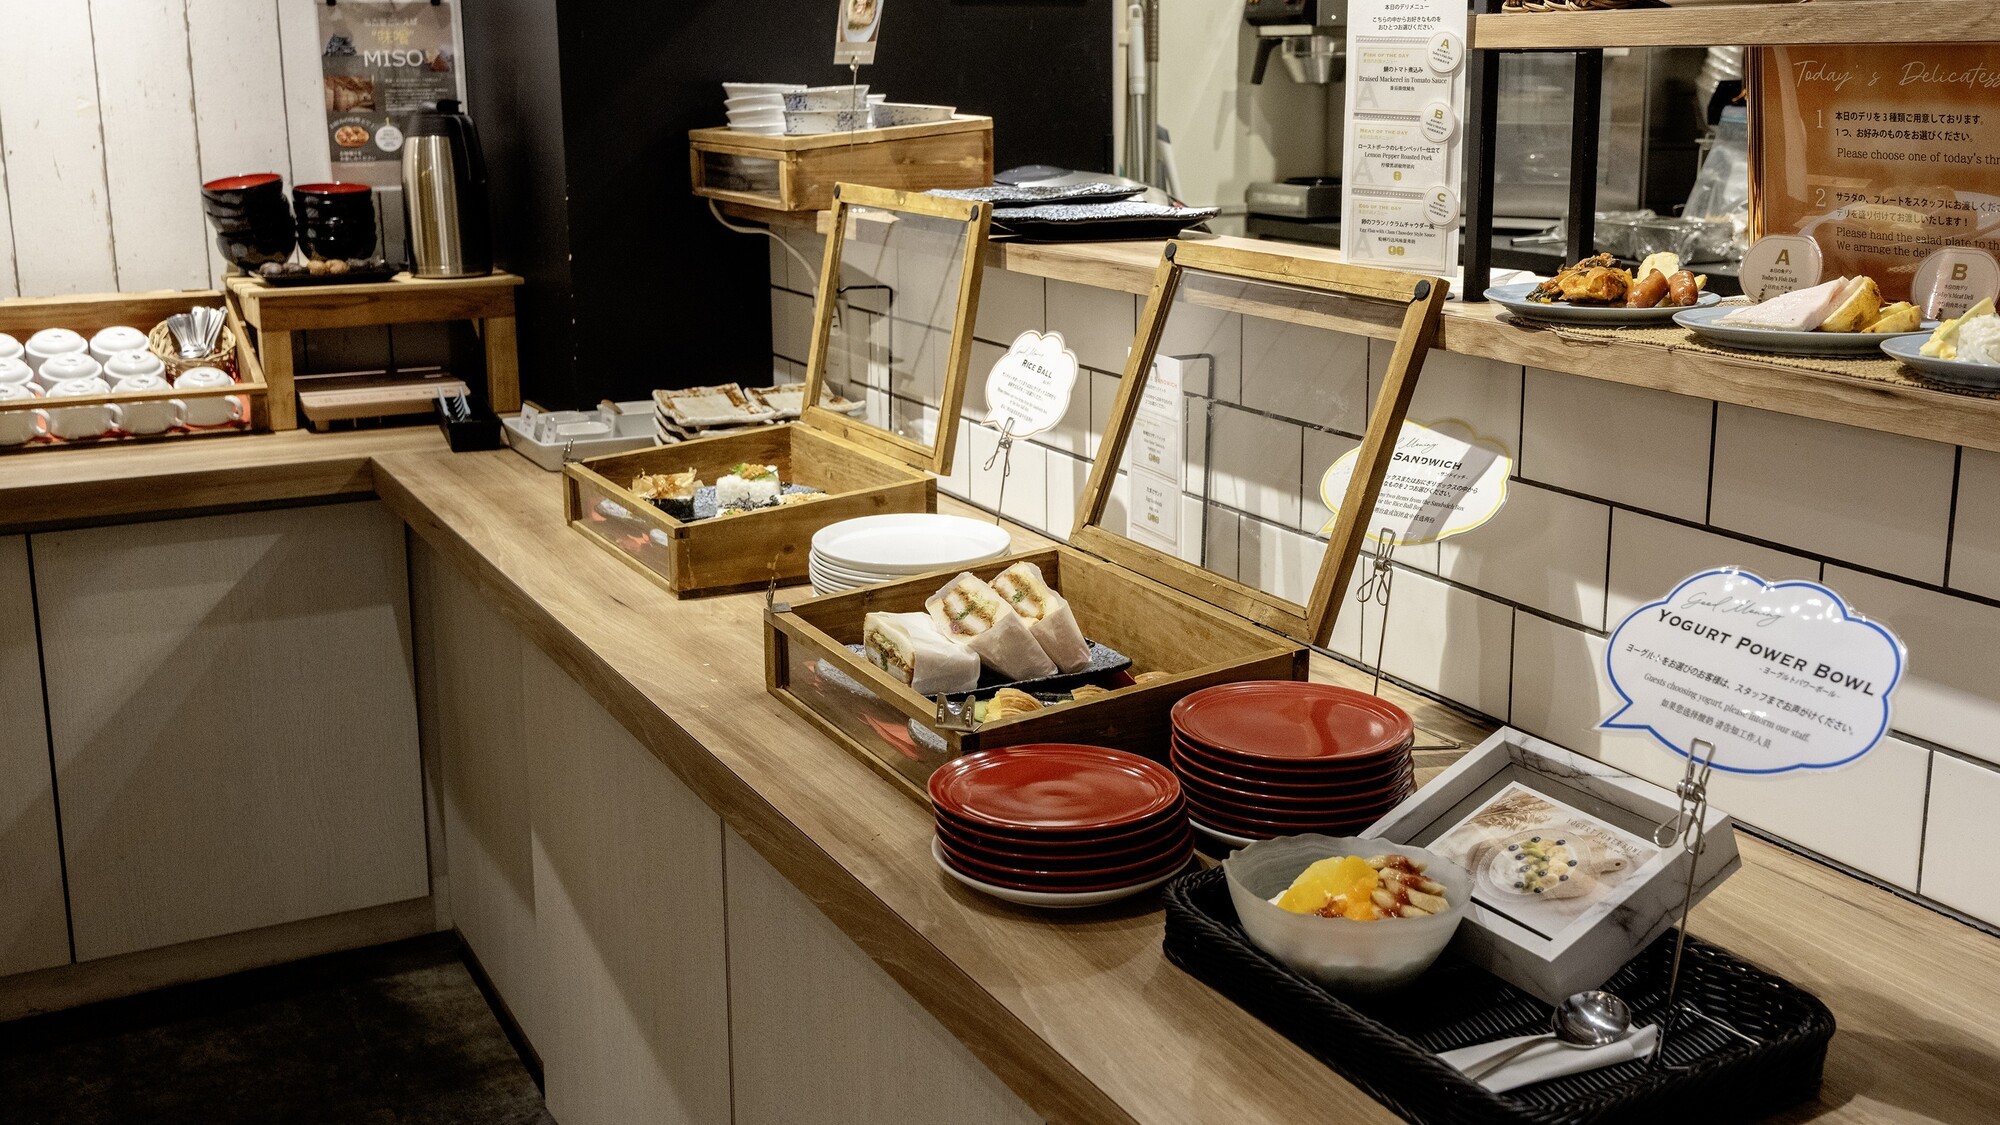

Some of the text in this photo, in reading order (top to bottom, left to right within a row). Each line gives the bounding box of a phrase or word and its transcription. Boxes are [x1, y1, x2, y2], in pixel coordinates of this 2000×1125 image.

[1441, 38, 1449, 49] A
[363, 50, 423, 67] MISO
[1359, 75, 1378, 83] Braised
[1435, 109, 1443, 120] B
[1816, 109, 1823, 129] 1
[1837, 147, 1868, 160] Please
[1870, 148, 1905, 161] choose
[1908, 152, 1926, 163] one
[1929, 151, 1942, 163] of
[1944, 152, 1982, 166] today's
[1437, 193, 1446, 202] C
[1815, 188, 1826, 207] 2
[1836, 227, 1868, 240] Please
[1870, 229, 1894, 242] hand
[1896, 231, 1913, 243] the
[1915, 233, 1942, 246] salad
[1945, 236, 1972, 248] plate
[1973, 239, 1986, 249] to
[1836, 240, 1851, 251] We
[1853, 243, 1891, 256] arrange
[1894, 244, 1910, 256] the
[1775, 249, 1790, 265] A
[1951, 263, 1968, 280] B
[1022, 359, 1052, 379] RICE BALL
[1393, 452, 1463, 470] SANDWICH
[1403, 502, 1413, 510] Ball
[1431, 500, 1455, 510] Sandwich
[1681, 591, 1720, 612] Good
[1658, 609, 1875, 696] YOGURT POWER BOWL
[1644, 672, 1811, 743] Guests choosing yogurt, please inform our staff.
[1566, 818, 1596, 835] YOGURT
[1596, 832, 1621, 847] POWER
